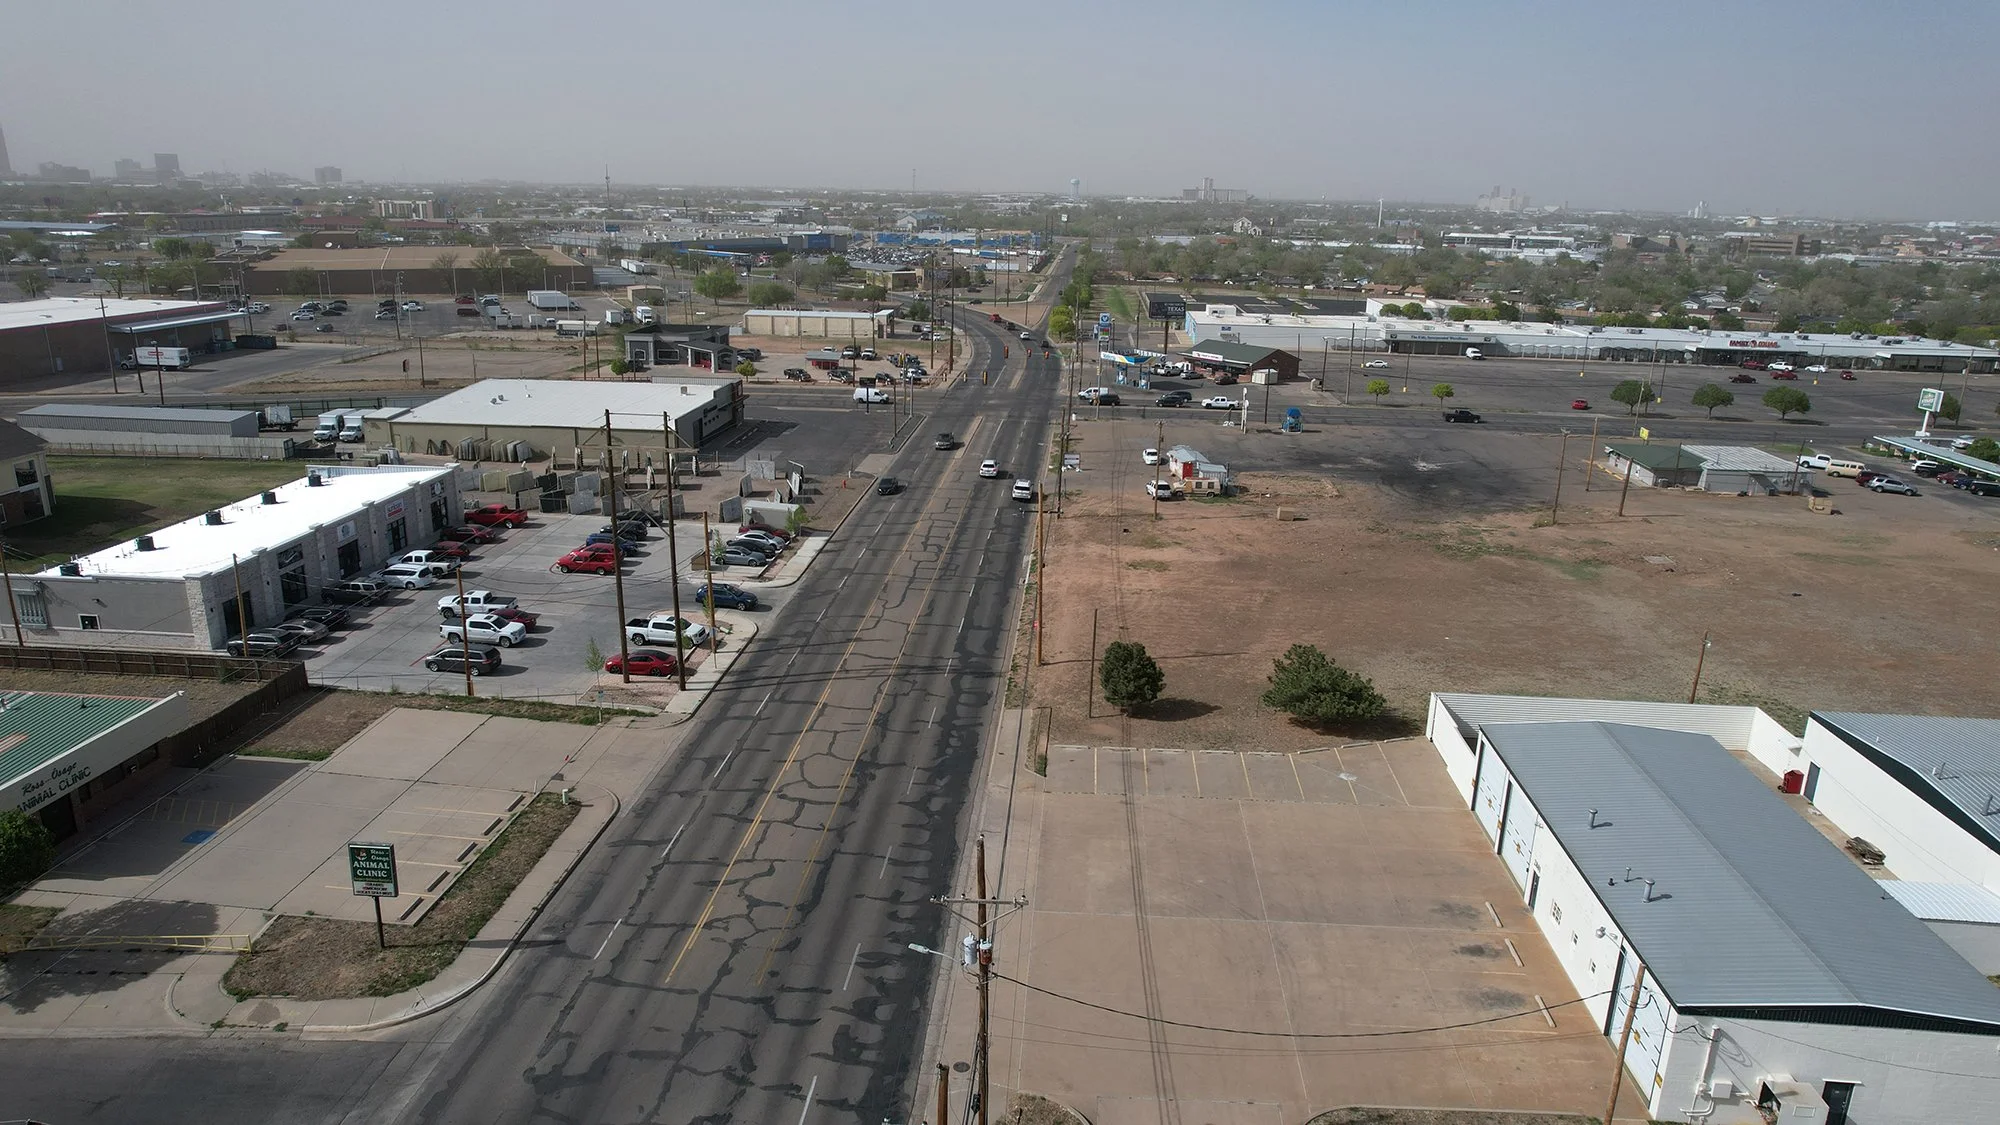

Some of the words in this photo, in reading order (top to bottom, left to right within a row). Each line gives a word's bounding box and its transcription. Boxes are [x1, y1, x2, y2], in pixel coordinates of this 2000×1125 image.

[59, 766, 91, 791] CLINIC
[353, 860, 390, 869] ANIMAL
[356, 869, 388, 878] CLINIC
